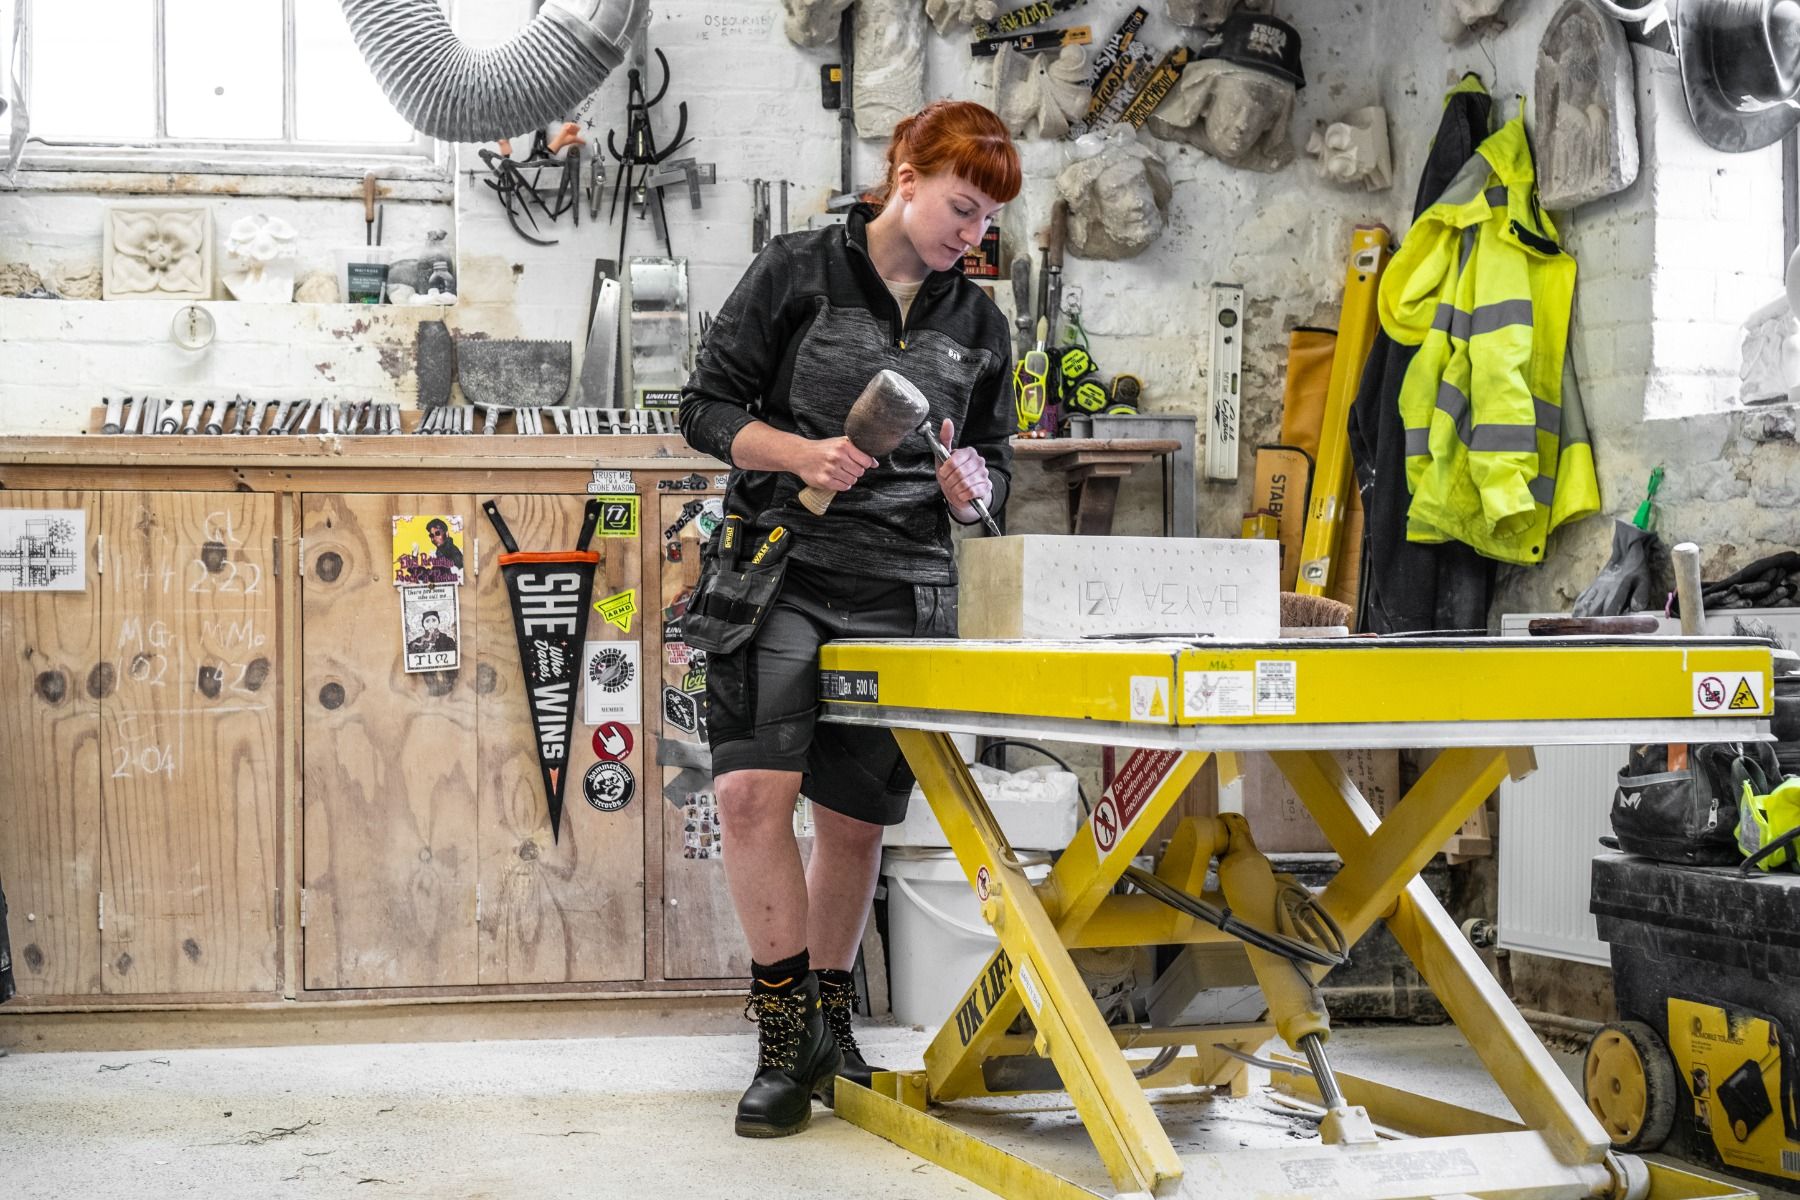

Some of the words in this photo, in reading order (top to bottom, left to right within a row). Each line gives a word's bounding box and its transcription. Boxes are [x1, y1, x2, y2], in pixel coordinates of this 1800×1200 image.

[589, 484, 610, 492] STONE
[611, 484, 635, 492] MASON
[595, 471, 617, 479] TRUST
[619, 471, 630, 480] ME
[752, 543, 769, 564] WALT
[516, 573, 581, 636] SHE
[549, 646, 564, 677] Who
[856, 678, 868, 696] 500
[869, 679, 878, 700] Kg
[533, 682, 570, 759] WINS
[1114, 781, 1123, 795] Do
[1122, 767, 1133, 785] not
[1131, 751, 1146, 772] enter
[1122, 771, 1144, 806] platform
[1143, 750, 1161, 774] unless
[1124, 769, 1158, 817] mechanically
[955, 988, 985, 1047] UK
